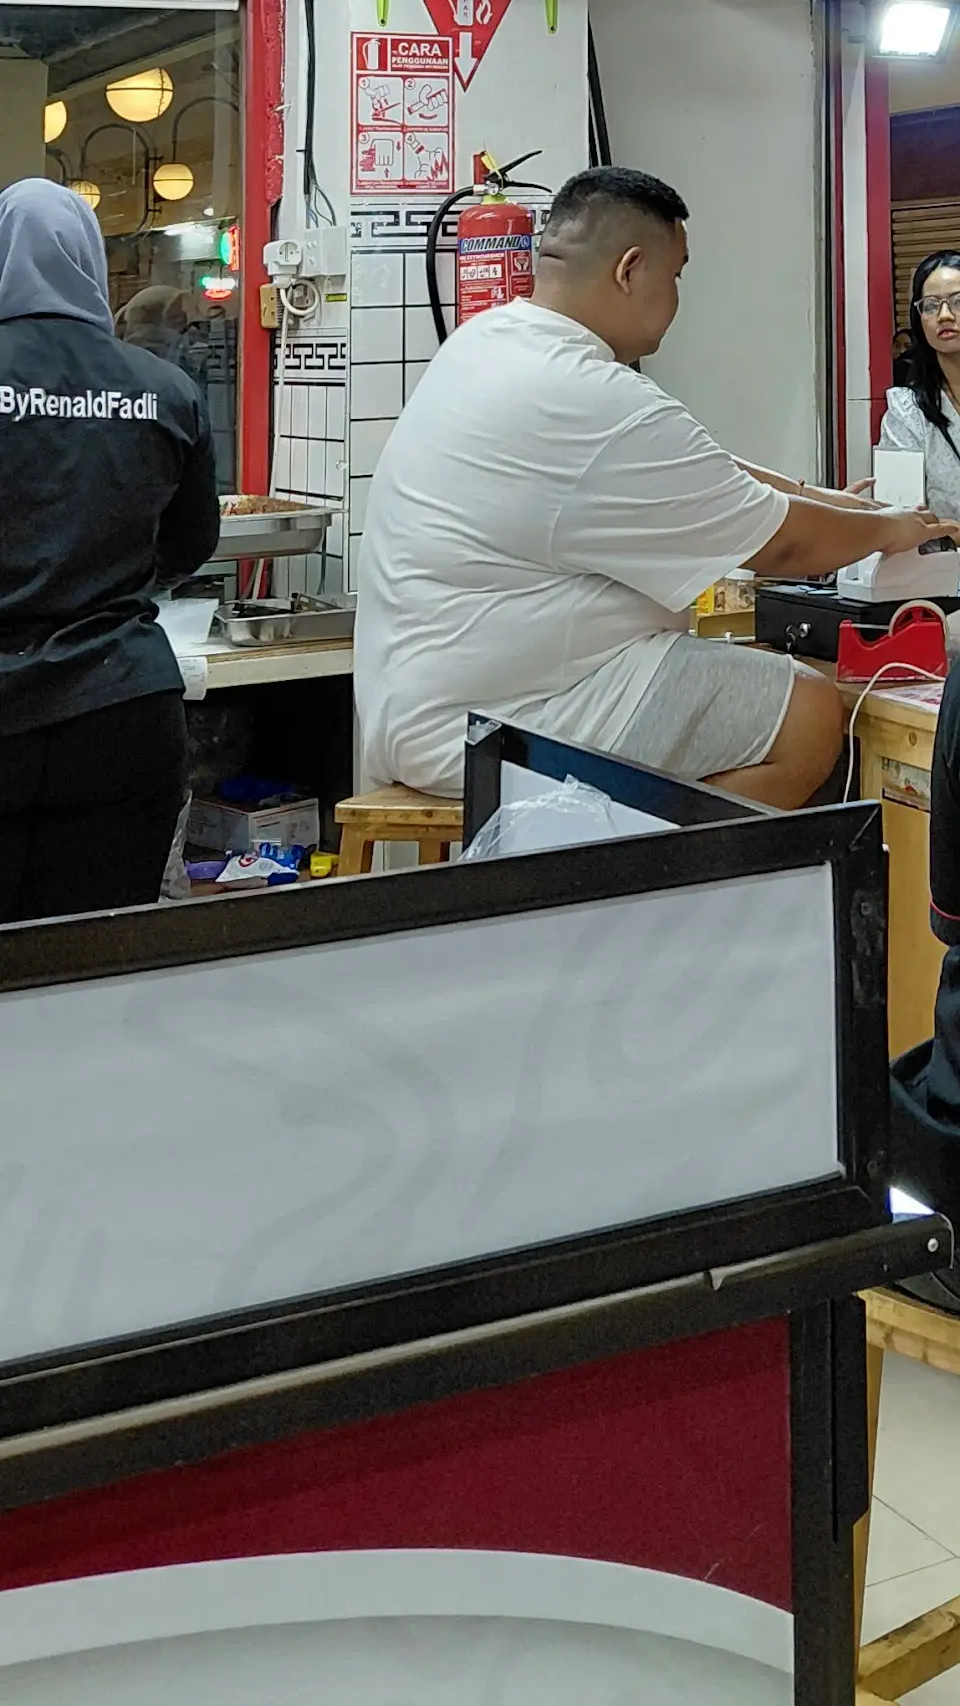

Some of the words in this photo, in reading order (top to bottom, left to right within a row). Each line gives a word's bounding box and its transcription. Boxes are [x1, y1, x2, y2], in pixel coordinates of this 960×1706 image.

[397, 42, 442, 57] CARA
[391, 56, 449, 65] PENGGUNAAN
[461, 236, 520, 251] COMMAND
[0, 386, 158, 422] ByRenaldFadli
